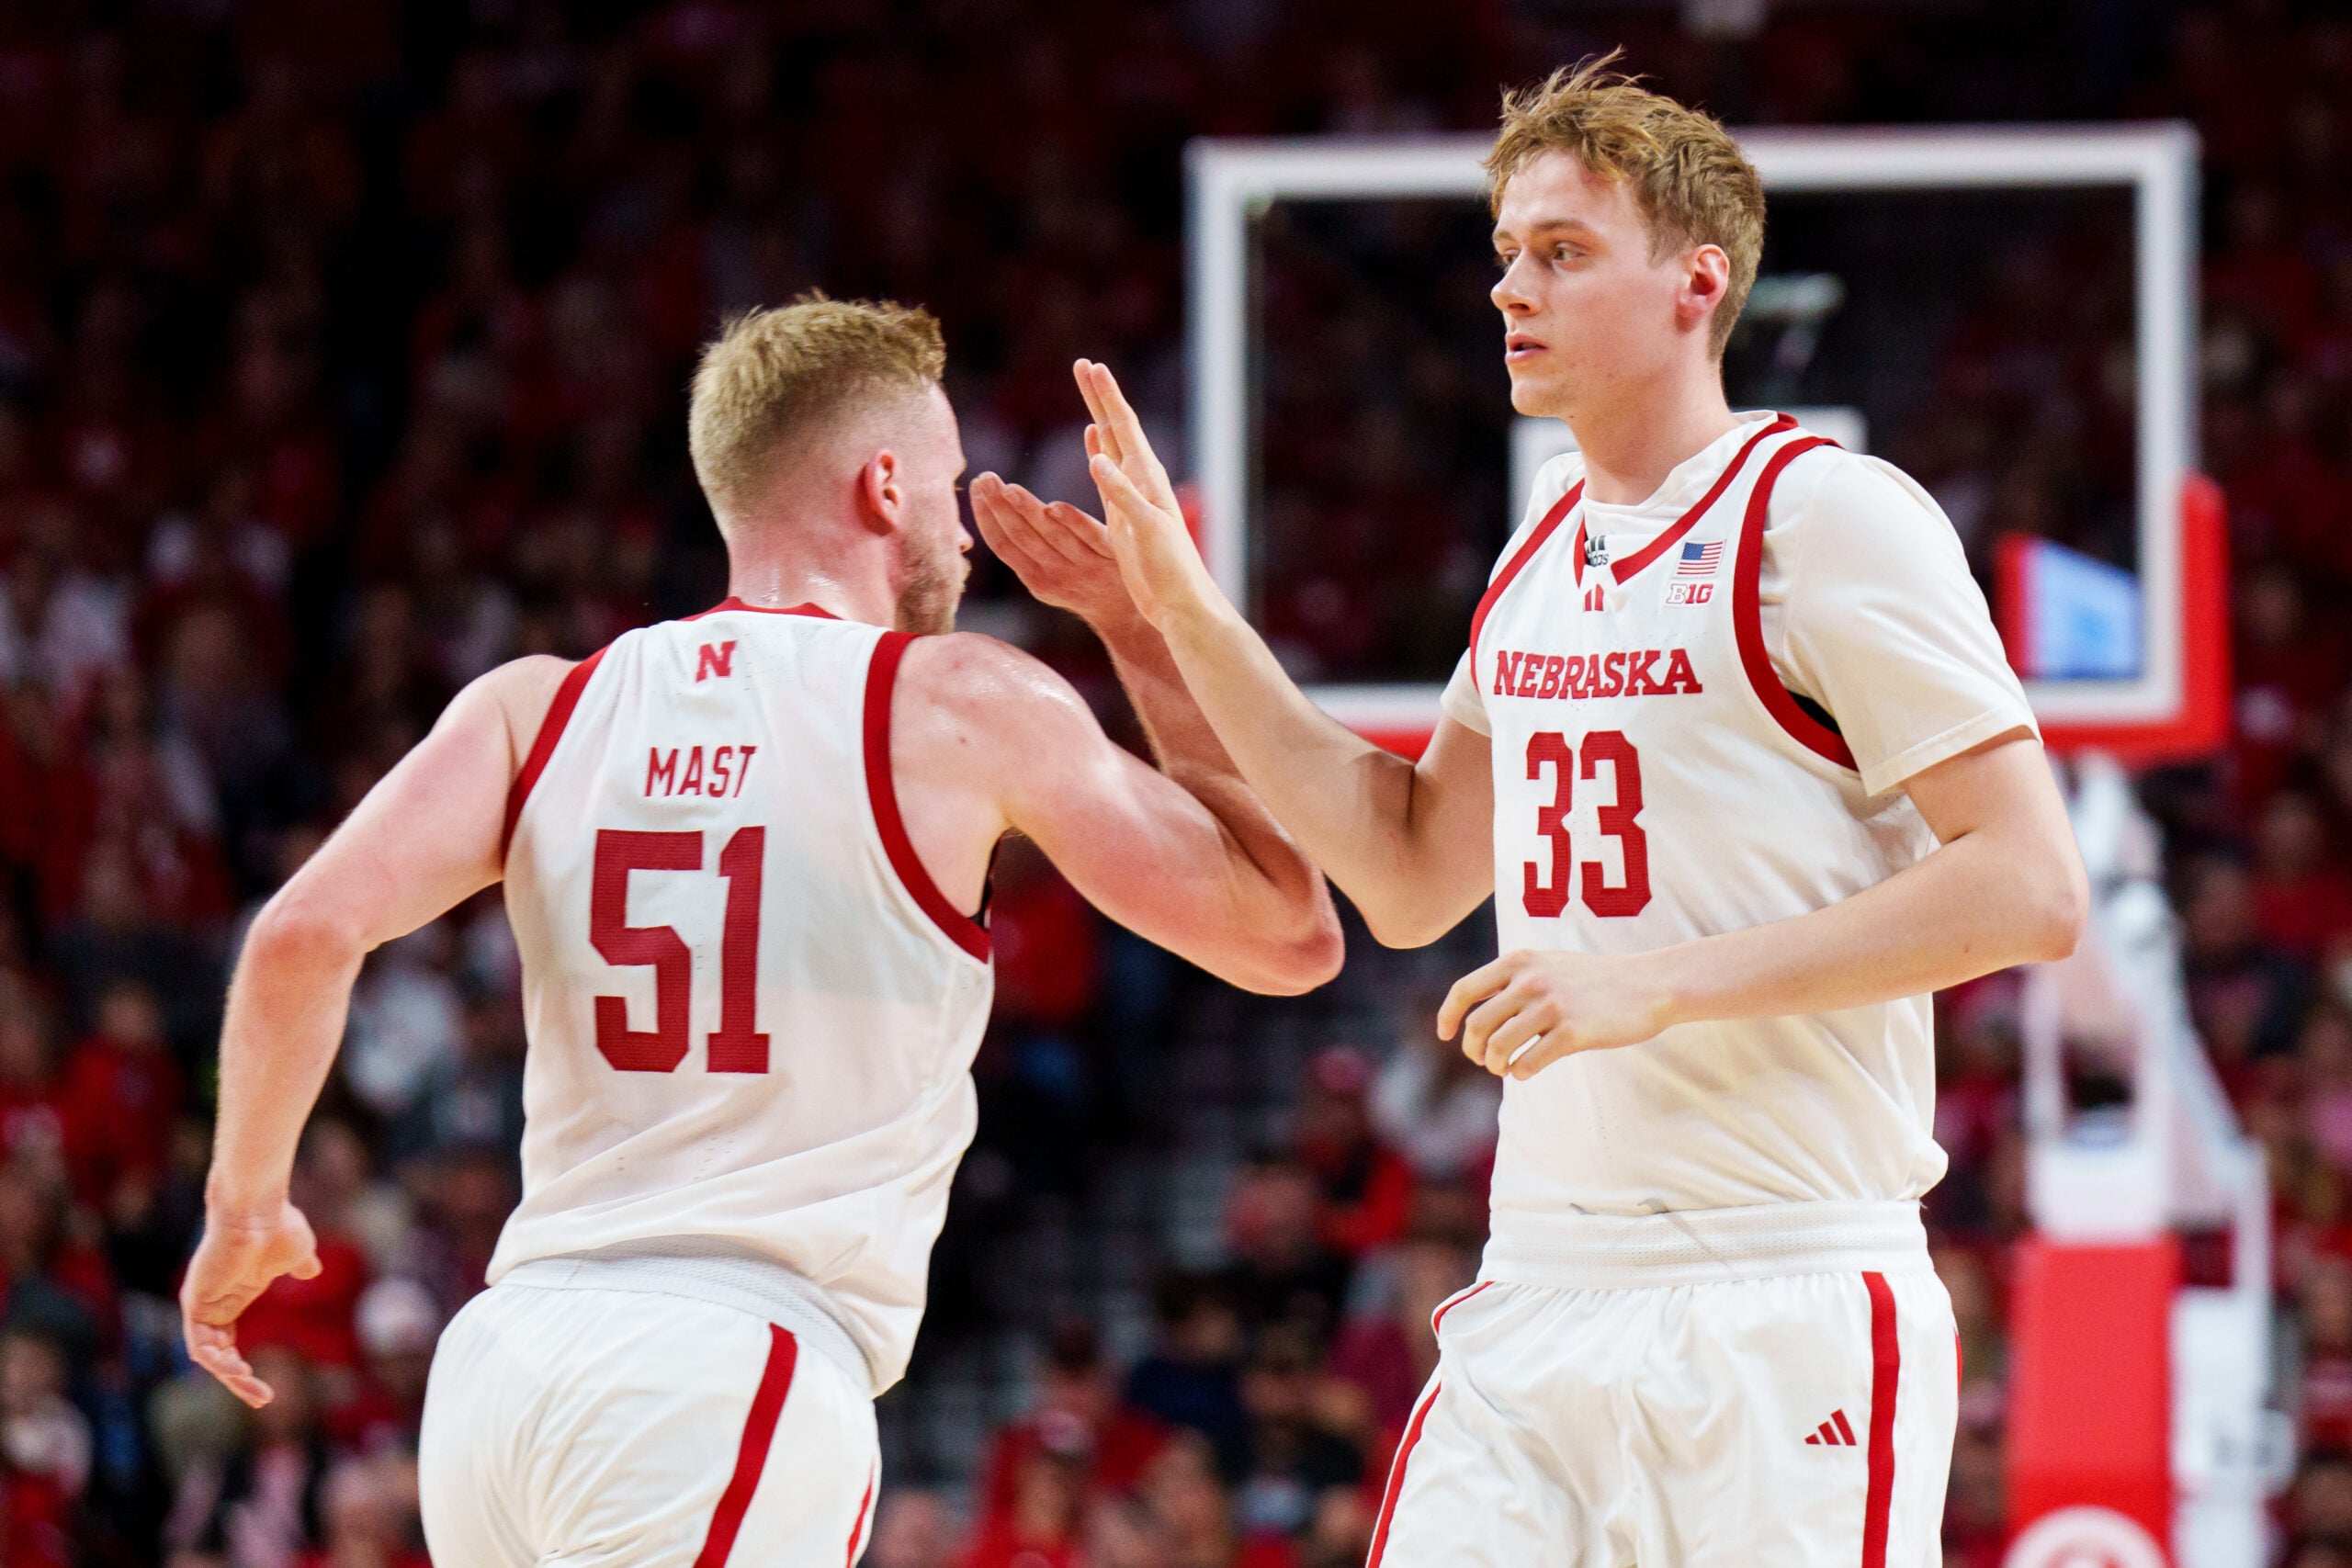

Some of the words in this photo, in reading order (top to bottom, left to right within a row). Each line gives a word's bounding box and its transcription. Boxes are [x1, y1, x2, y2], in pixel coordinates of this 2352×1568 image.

[695, 640, 737, 682] N
[1493, 648, 1702, 699] NEBRASKA
[645, 745, 756, 797] MAST
[1522, 730, 1652, 918] 33
[590, 826, 770, 1074] 51
